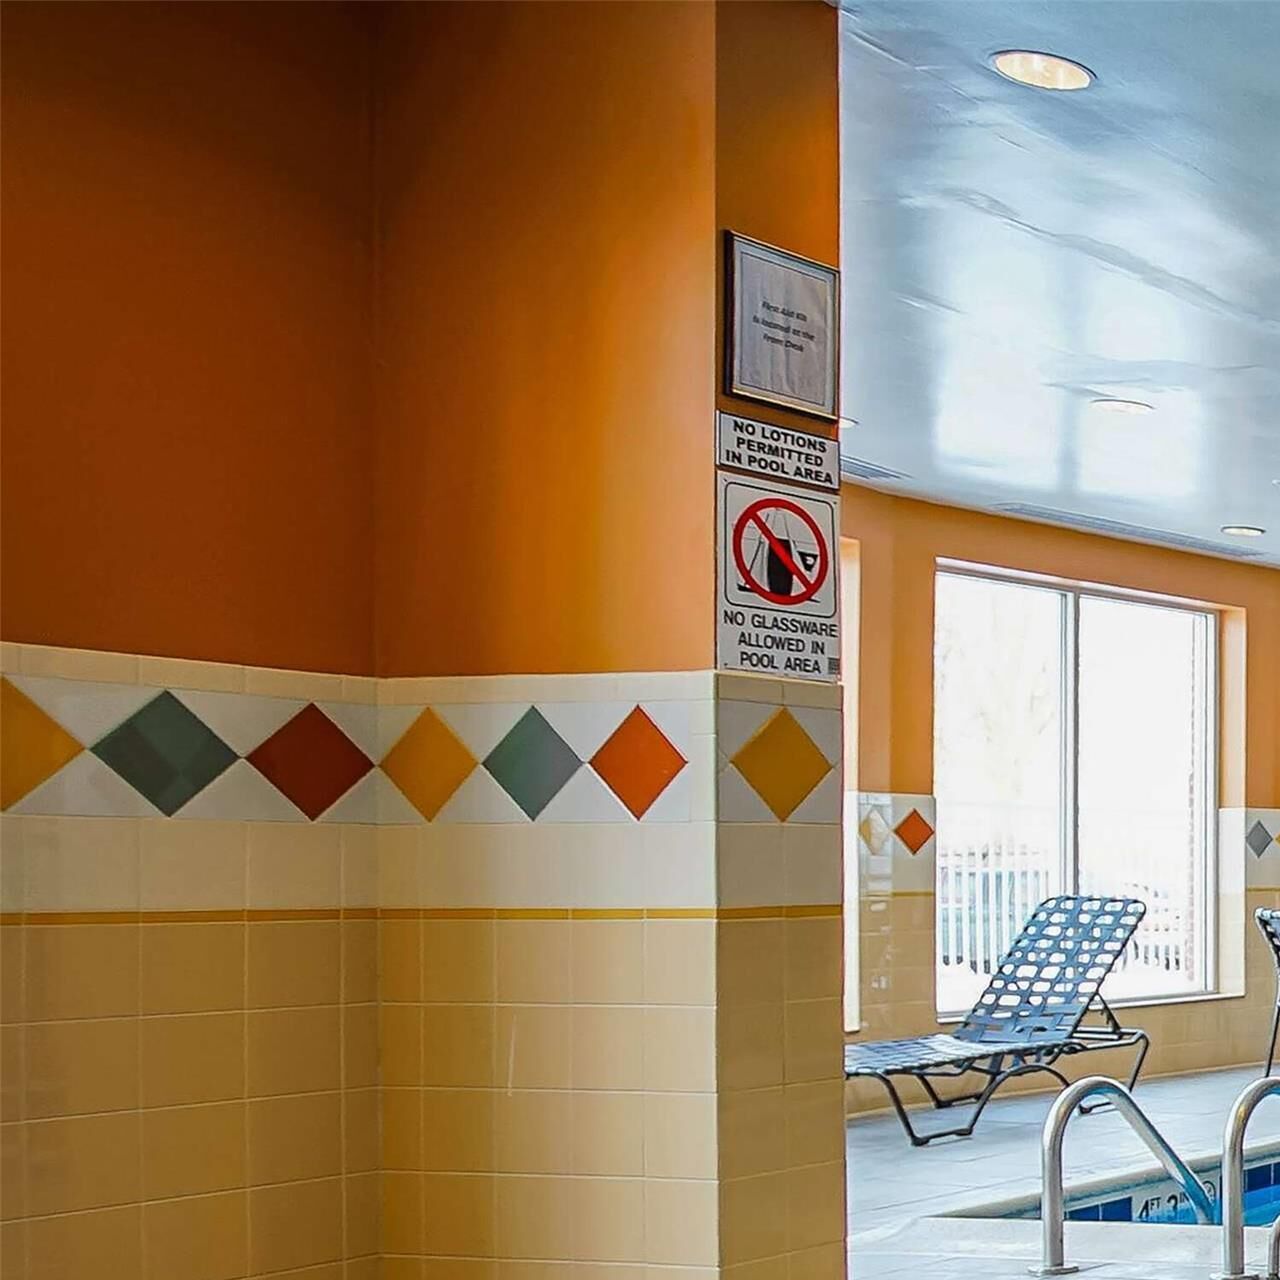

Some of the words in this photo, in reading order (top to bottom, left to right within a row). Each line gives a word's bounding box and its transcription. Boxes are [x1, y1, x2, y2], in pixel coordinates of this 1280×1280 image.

[732, 420, 756, 436] NO
[761, 428, 828, 453] LOTIONS
[736, 438, 824, 467] PERMITTED
[726, 450, 742, 465] IN
[748, 456, 789, 476] POOL
[794, 466, 833, 485] AREA
[723, 610, 746, 627] NO
[752, 615, 838, 637] GLASSWARE
[738, 632, 806, 653] ALLOWED
[811, 640, 825, 654] IN
[740, 653, 778, 669] POOL
[784, 659, 821, 674] AREA
